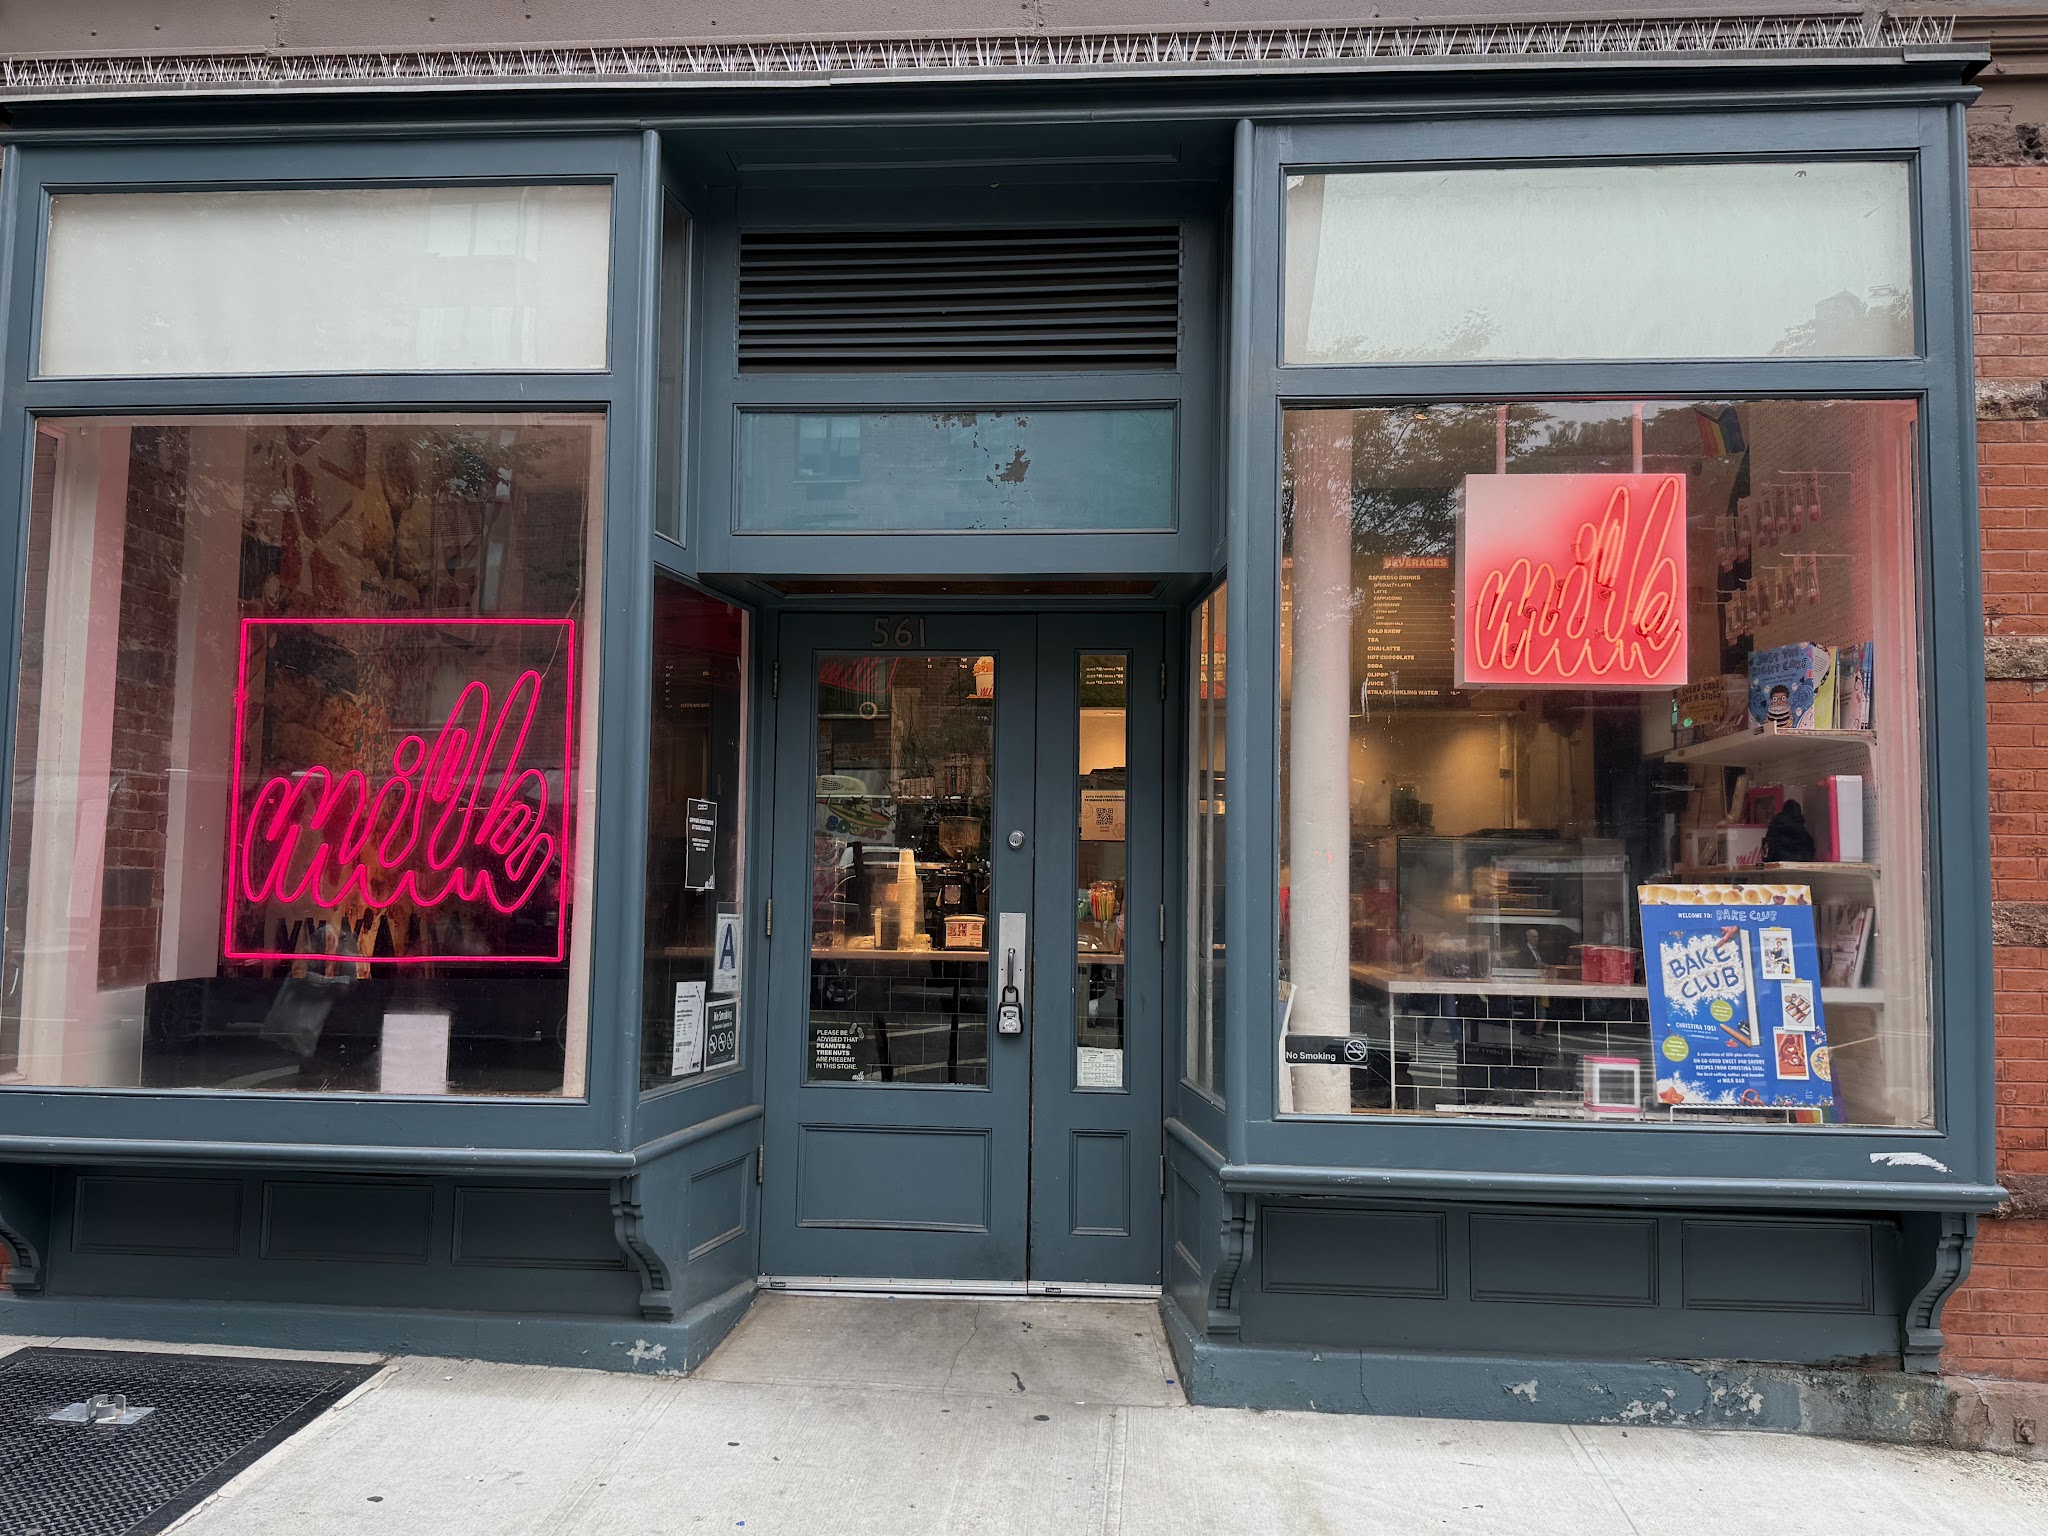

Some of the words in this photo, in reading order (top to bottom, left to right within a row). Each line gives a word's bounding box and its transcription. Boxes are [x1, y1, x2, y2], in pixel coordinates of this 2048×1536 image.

[1384, 558, 1447, 567] BEVERAGES
[1474, 475, 1682, 680] milk
[871, 616, 926, 648] 561
[1751, 664, 1780, 676] RIGHT
[1783, 658, 1808, 672] CAKE
[1756, 653, 1778, 666] JUST
[1703, 681, 1720, 691] CAKE
[242, 669, 554, 913] milk
[1716, 909, 1746, 921] BAKE
[1749, 910, 1778, 921] CLUB
[718, 924, 735, 970] A
[1668, 946, 1731, 978] BAKE
[1681, 966, 1739, 999] CLUB
[714, 1010, 718, 1022] No
[718, 1010, 732, 1020] Smoking
[1676, 1022, 1702, 1030] CHRISTINA
[1286, 1052, 1298, 1060] No
[1300, 1052, 1336, 1062] Smoking
